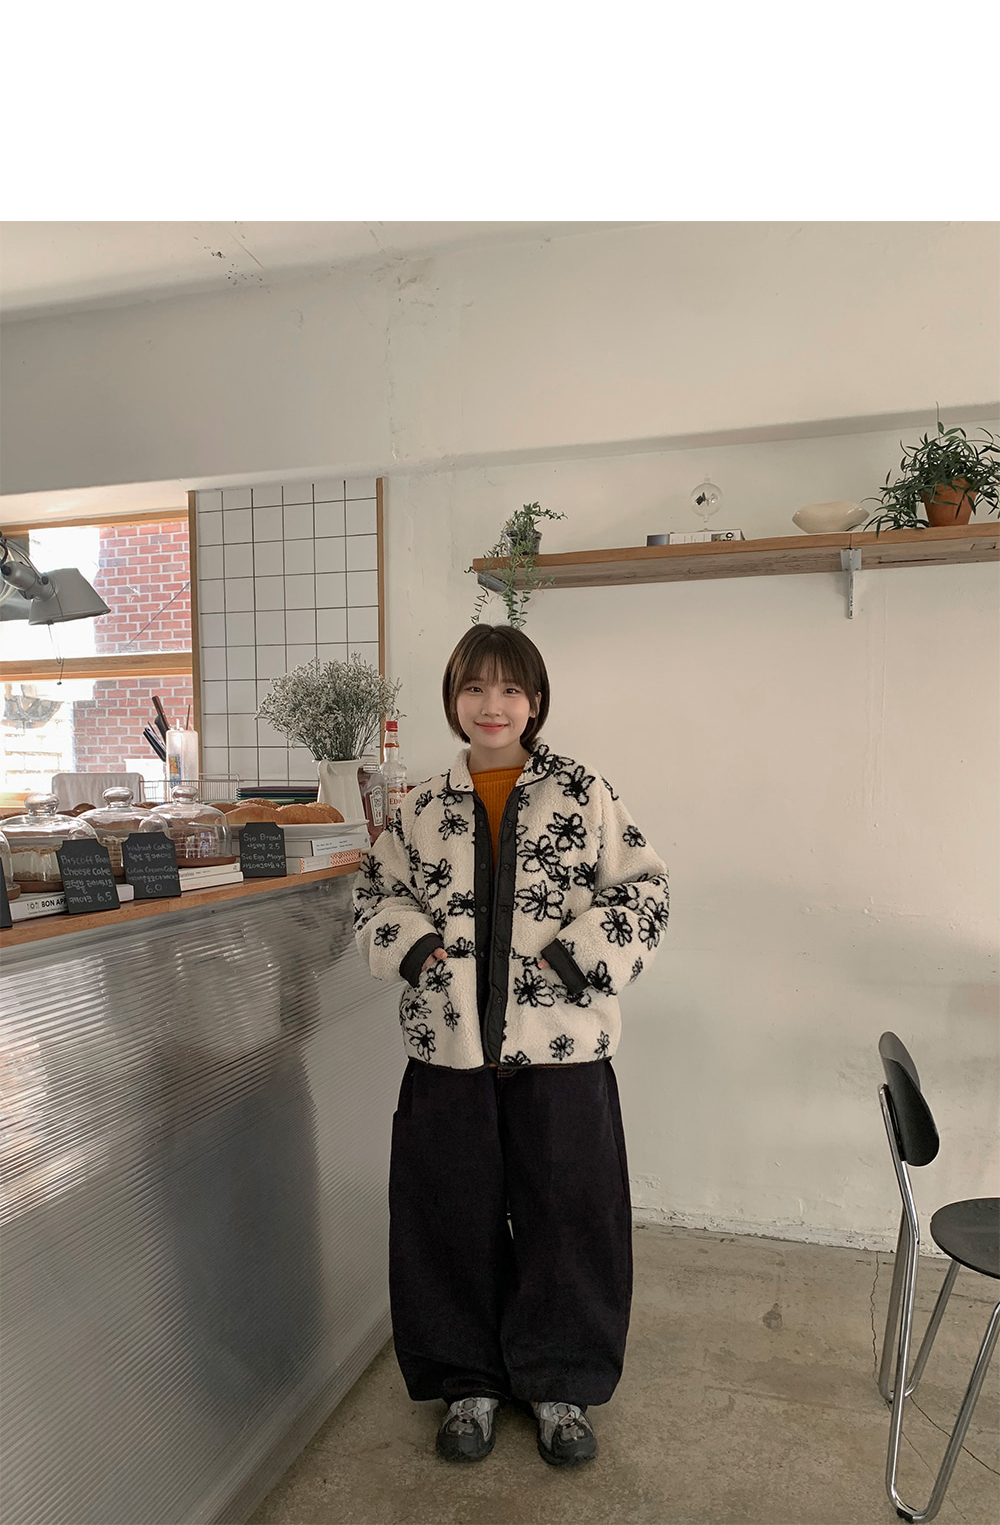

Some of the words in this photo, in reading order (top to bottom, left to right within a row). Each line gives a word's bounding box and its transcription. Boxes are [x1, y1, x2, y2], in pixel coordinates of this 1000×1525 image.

[243, 832, 257, 842] Sio
[260, 832, 282, 841] Bread
[60, 854, 93, 865] Biscoff
[63, 867, 91, 876] Cheese
[92, 867, 111, 876] Cake
[145, 883, 163, 894] 6.0
[96, 891, 112, 903] 6.5
[41, 899, 55, 908] BON
